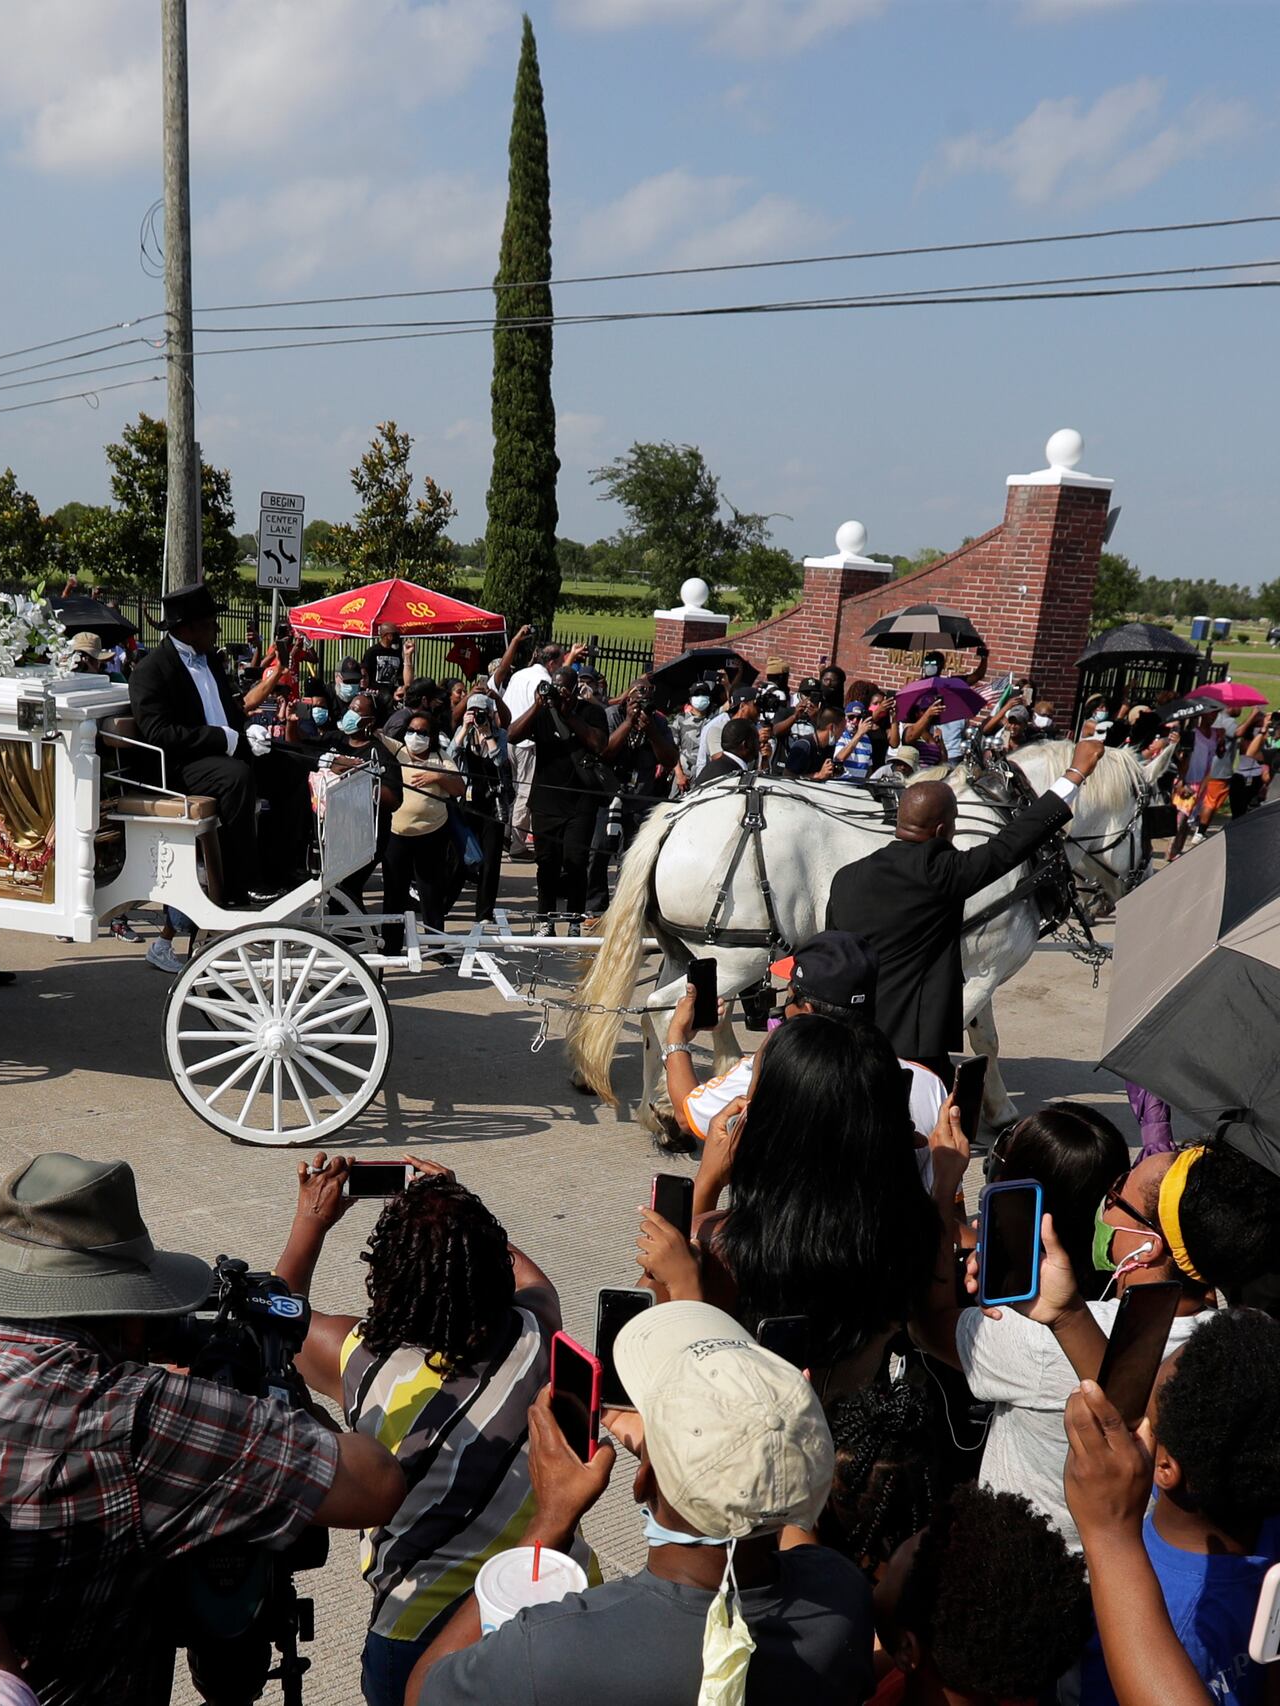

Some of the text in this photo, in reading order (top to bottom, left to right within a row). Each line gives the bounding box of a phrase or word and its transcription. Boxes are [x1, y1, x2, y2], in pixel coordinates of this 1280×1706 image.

[270, 496, 296, 508] BEGIN
[266, 515, 298, 525] CENTER
[270, 526, 293, 534] LANE
[268, 575, 290, 585] ONLY
[406, 602, 436, 618] 88
